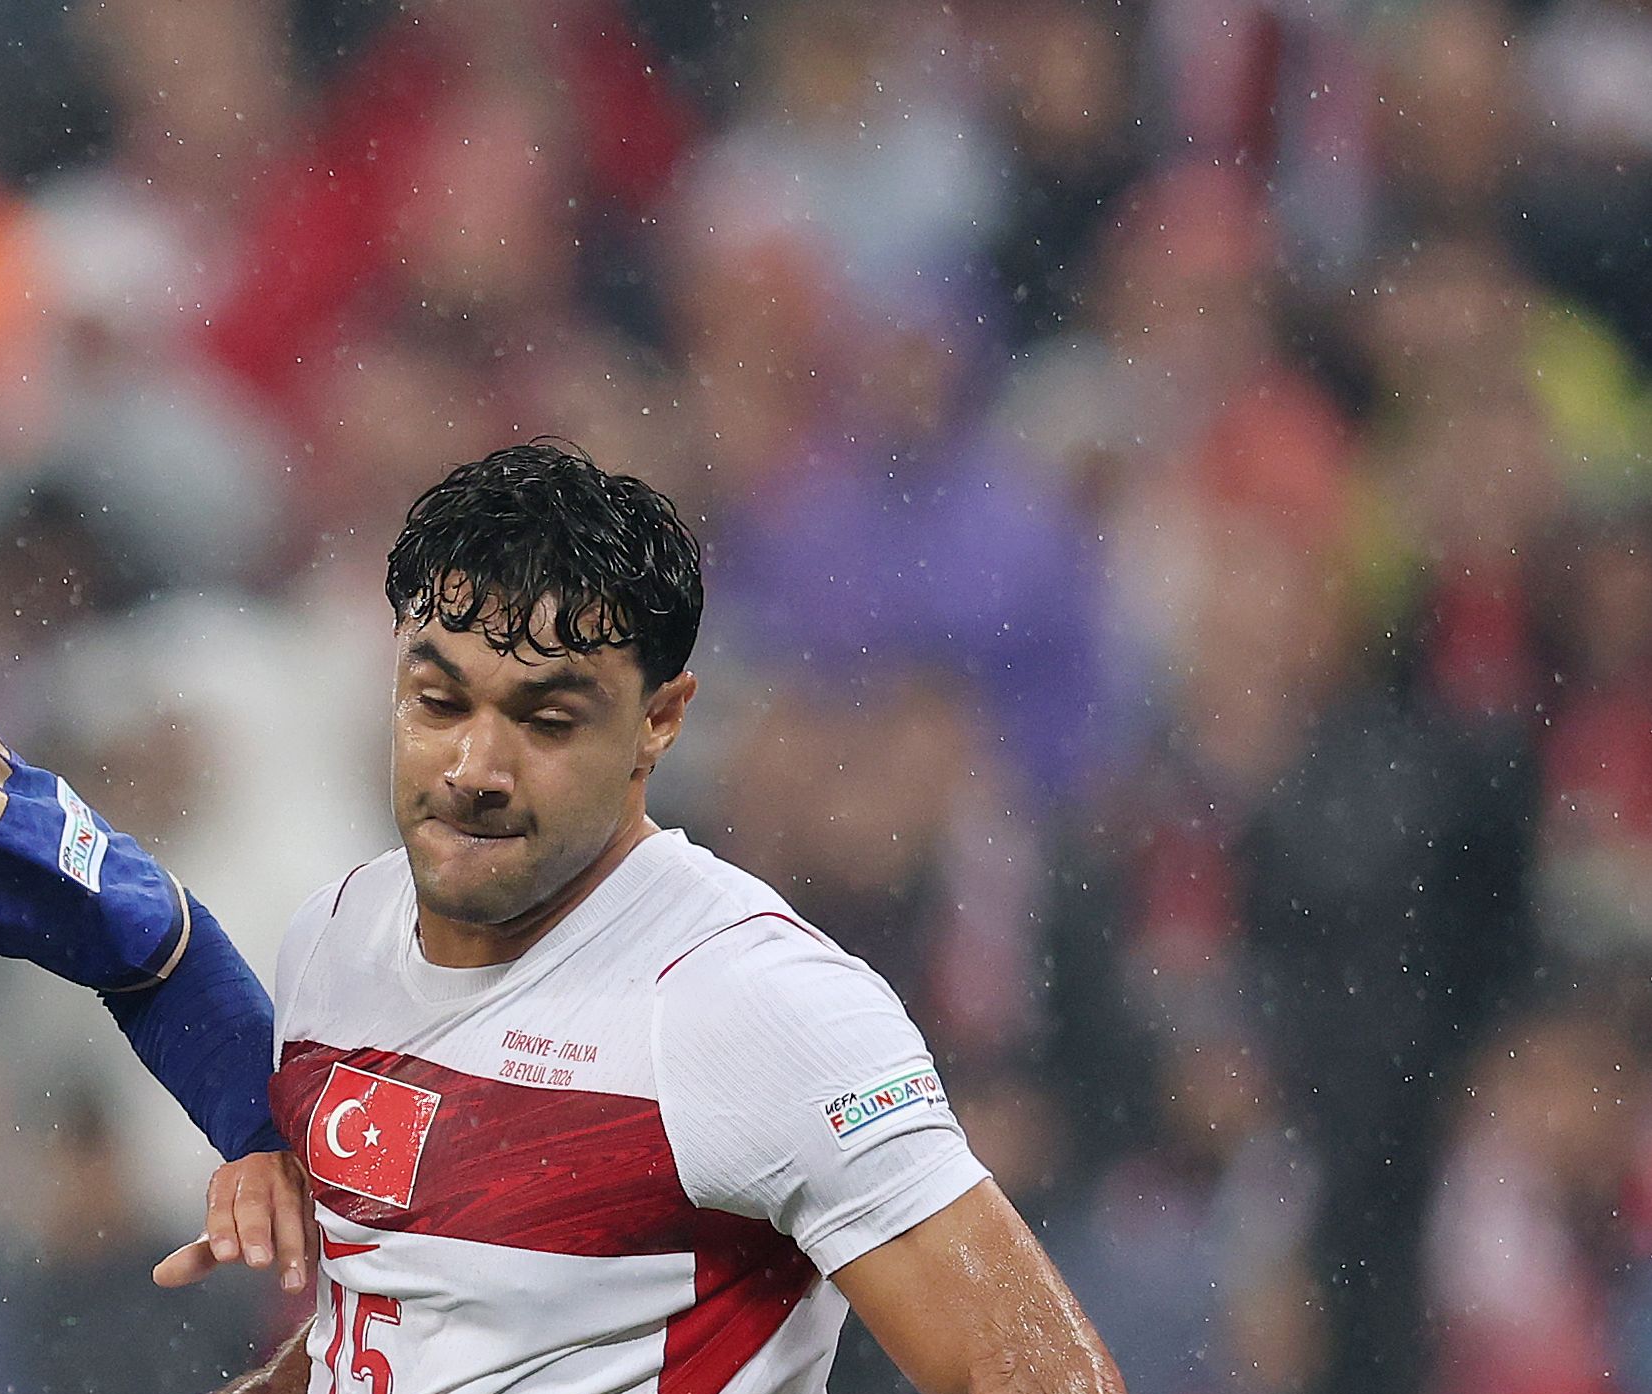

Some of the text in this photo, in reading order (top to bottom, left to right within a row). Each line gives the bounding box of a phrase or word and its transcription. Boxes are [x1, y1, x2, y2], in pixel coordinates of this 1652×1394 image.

[501, 1029, 554, 1057] TÜRKİYE
[557, 1040, 598, 1063] İTALYA
[499, 1059, 575, 1087] 28 EYLÜL 2026
[824, 1092, 858, 1116] UEFA
[830, 1075, 939, 1134] FOUNDATIO
